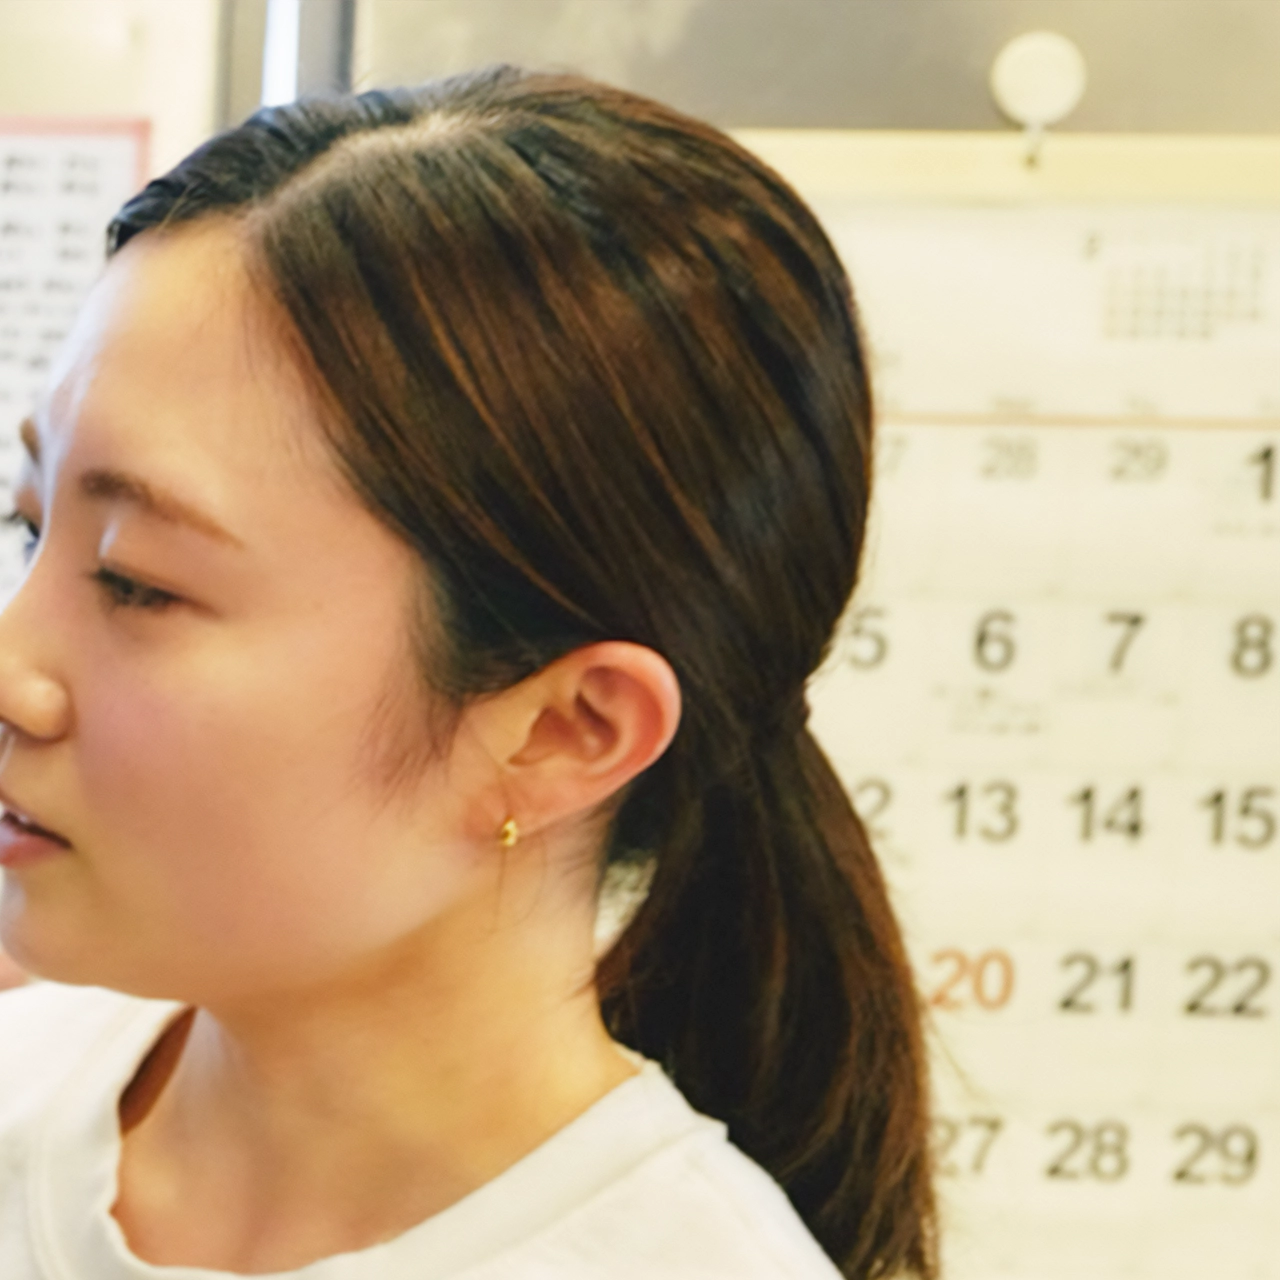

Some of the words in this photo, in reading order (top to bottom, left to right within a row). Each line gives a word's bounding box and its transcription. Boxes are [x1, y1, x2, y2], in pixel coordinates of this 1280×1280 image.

[980, 435, 1039, 481] 28
[1108, 435, 1171, 483] 29
[1247, 444, 1277, 503] 1
[845, 606, 888, 671] 5
[972, 608, 1019, 674] 6
[1104, 611, 1147, 676] 7
[1229, 613, 1275, 678] 8
[851, 776, 895, 842] 2
[944, 779, 1020, 843] 13
[1066, 784, 1148, 844] 14
[1197, 785, 1278, 850] 15
[928, 948, 1016, 1012] 20
[1057, 951, 1137, 1015] 21
[1183, 954, 1273, 1019] 22
[1045, 1116, 1131, 1184] 28
[1172, 1119, 1261, 1187] 29
